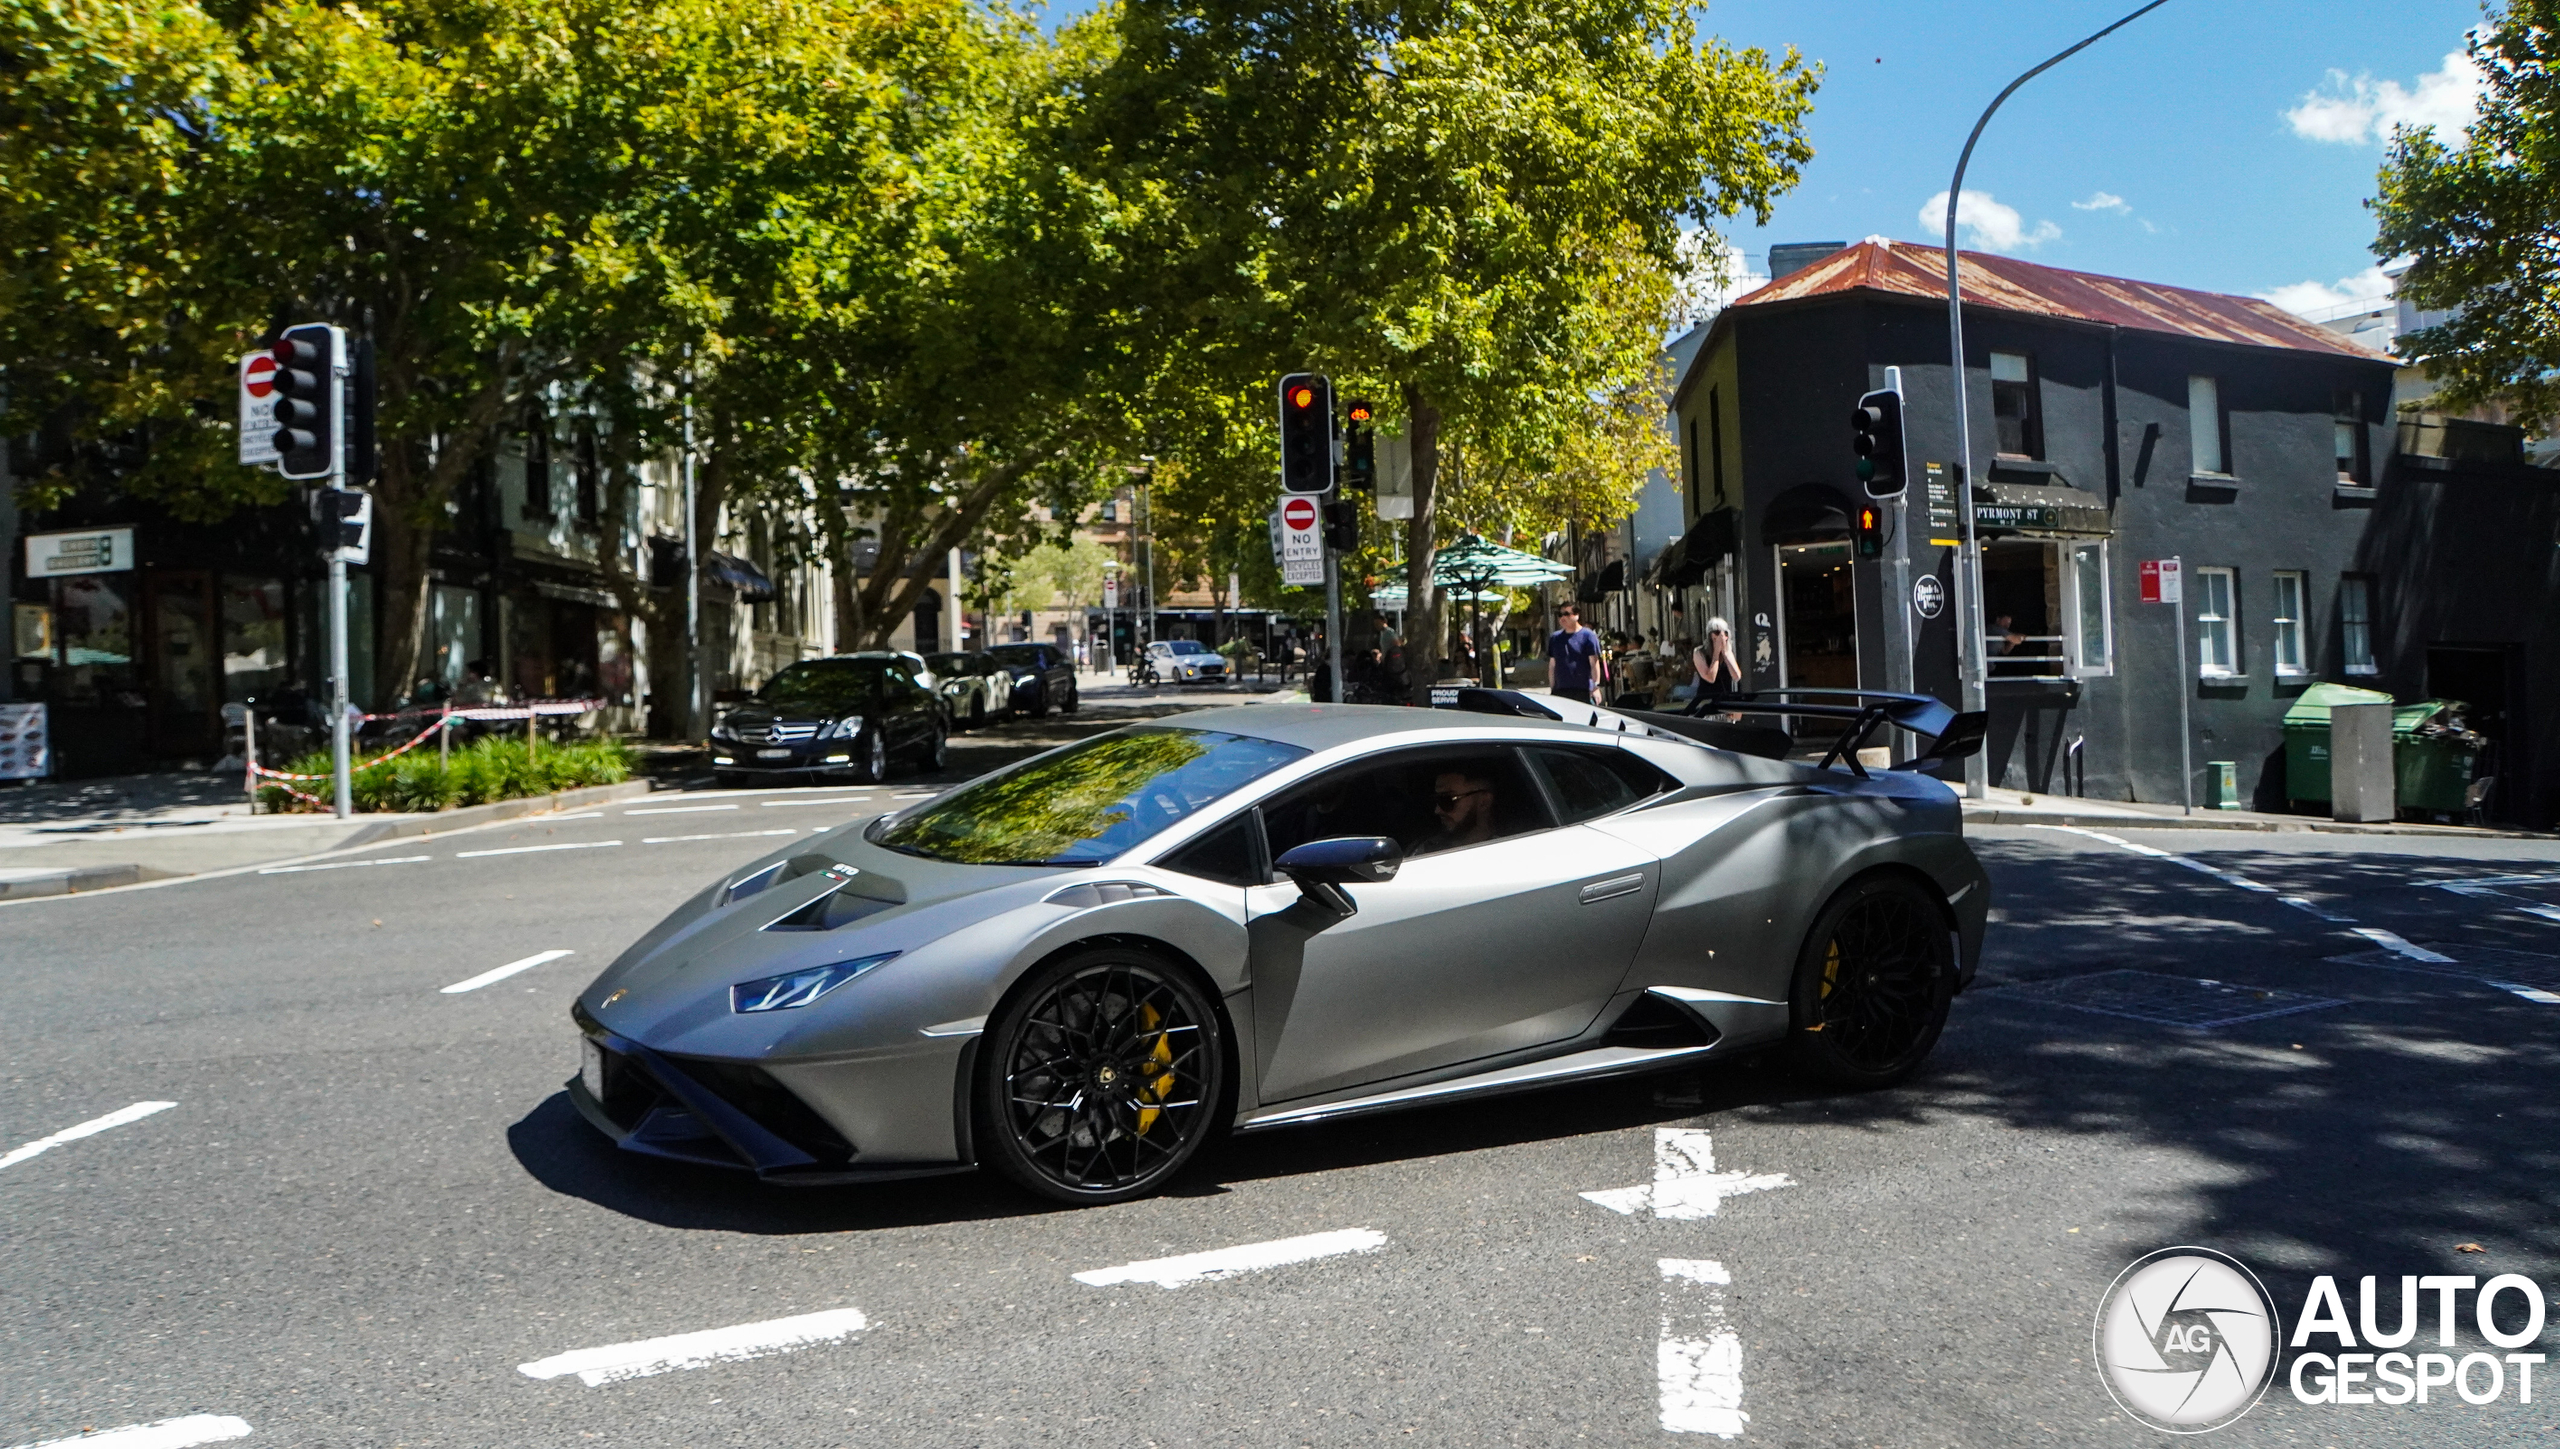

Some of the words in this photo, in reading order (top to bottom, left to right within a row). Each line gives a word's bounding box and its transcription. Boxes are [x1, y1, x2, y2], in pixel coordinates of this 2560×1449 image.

[1976, 507, 2022, 519] PYRMONT
[2026, 508, 2039, 520] ST
[1292, 533, 1311, 544] NO
[1286, 547, 1318, 557] ENTRY
[1287, 561, 1320, 571] BICYCLES
[1287, 570, 1321, 580] EXCEPTED
[1917, 584, 1940, 593] Quick
[1917, 592, 1941, 601] Brown
[1754, 612, 1771, 628] Q
[832, 863, 859, 875] STO
